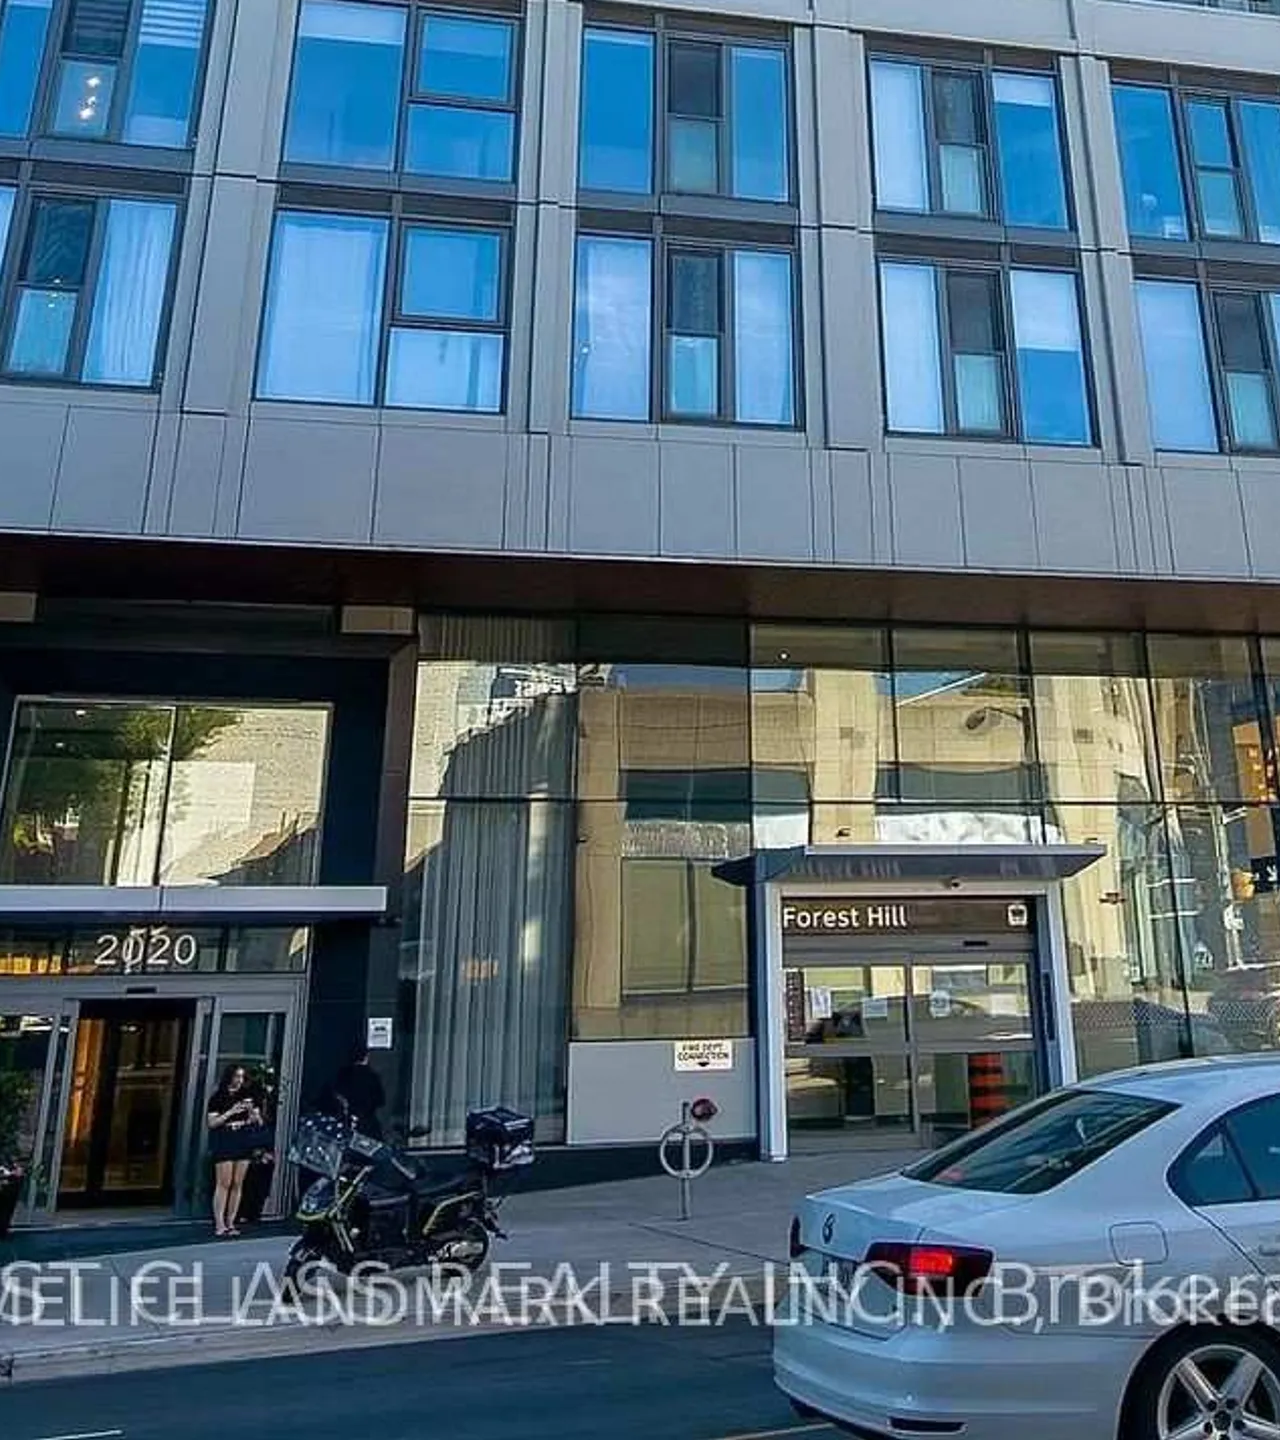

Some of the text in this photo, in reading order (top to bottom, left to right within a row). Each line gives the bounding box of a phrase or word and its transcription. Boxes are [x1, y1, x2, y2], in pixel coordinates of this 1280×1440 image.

[783, 905, 908, 928] Forest Hill
[94, 934, 196, 965] 2020
